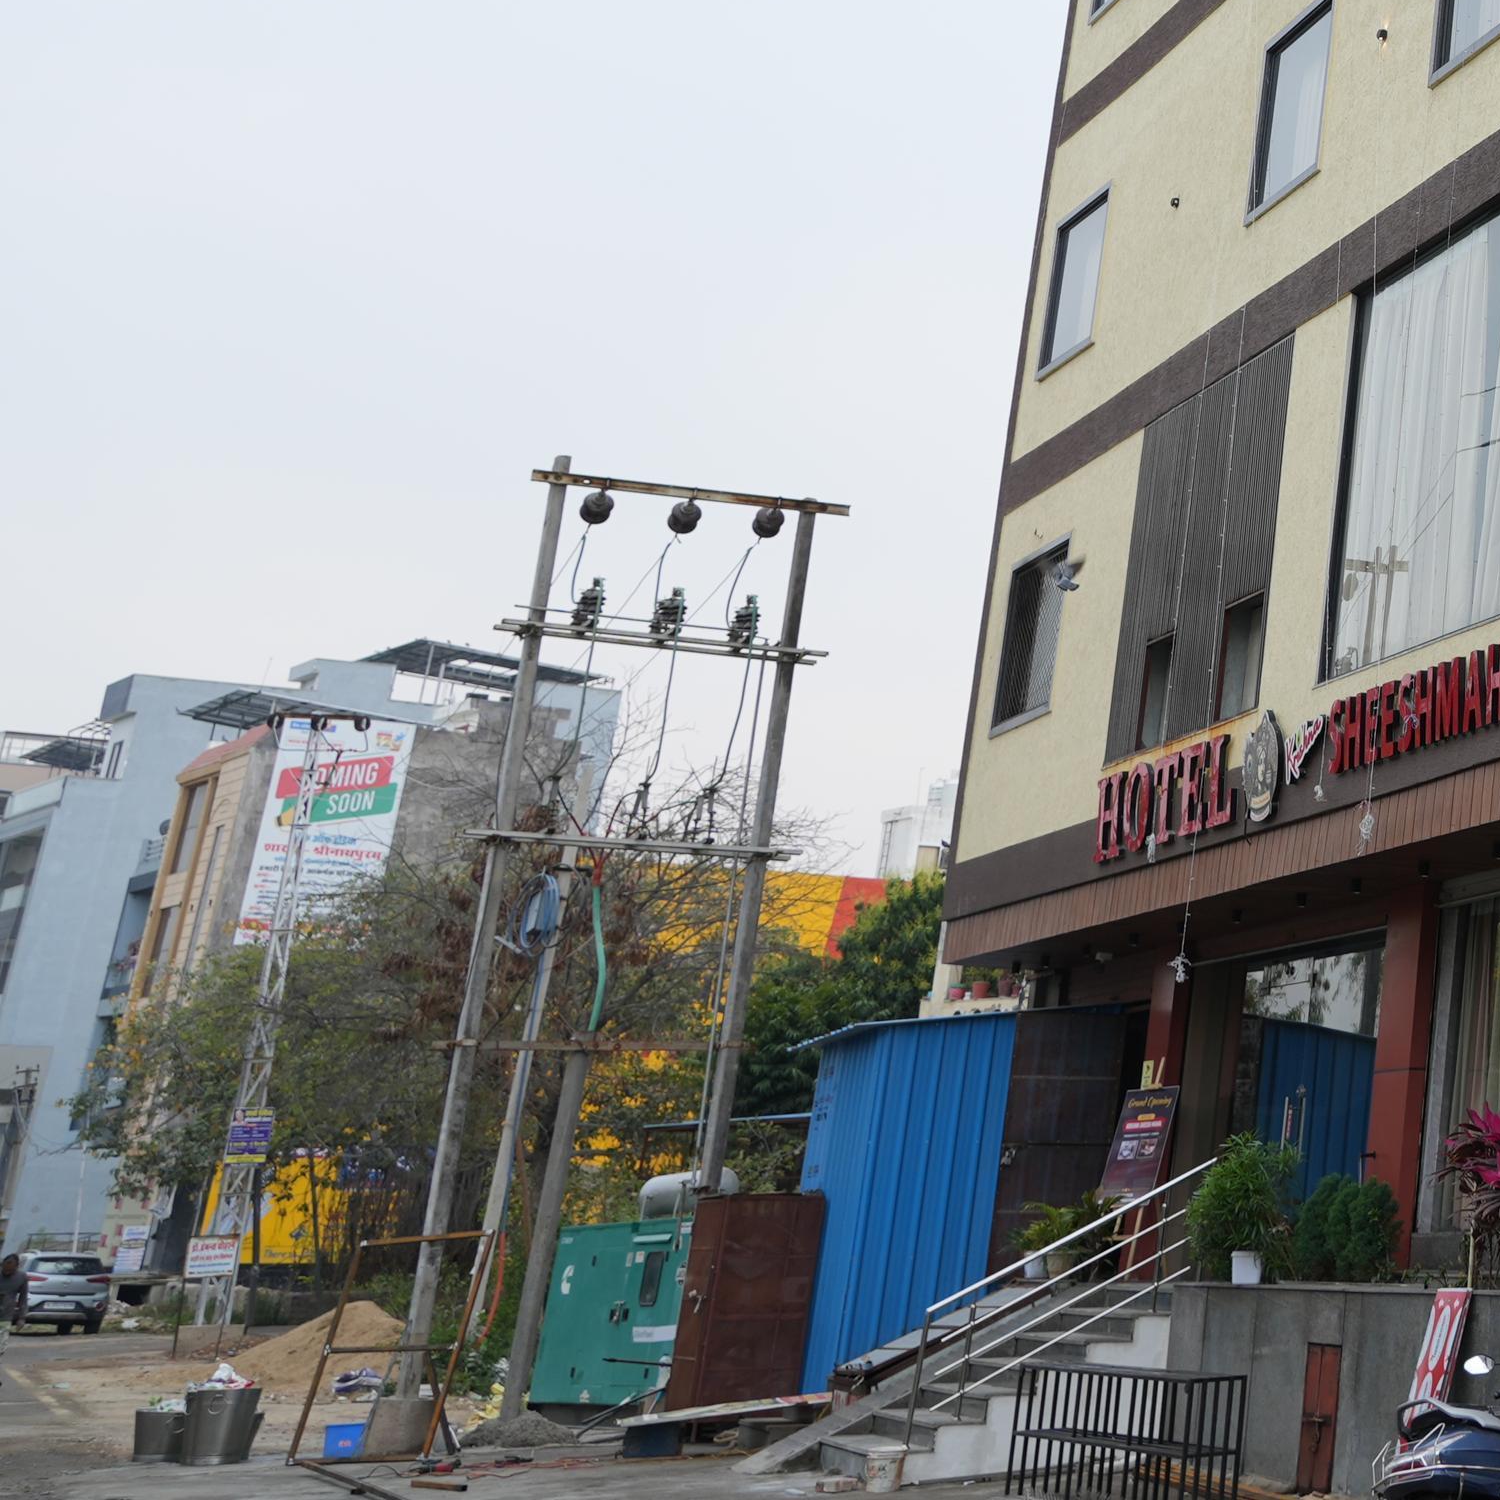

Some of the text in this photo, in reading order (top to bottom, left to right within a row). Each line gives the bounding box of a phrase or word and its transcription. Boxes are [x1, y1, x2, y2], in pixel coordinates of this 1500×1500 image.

[303, 762, 379, 795] OMING
[326, 791, 376, 815] SOON
[1093, 734, 1236, 863] HOTEL
